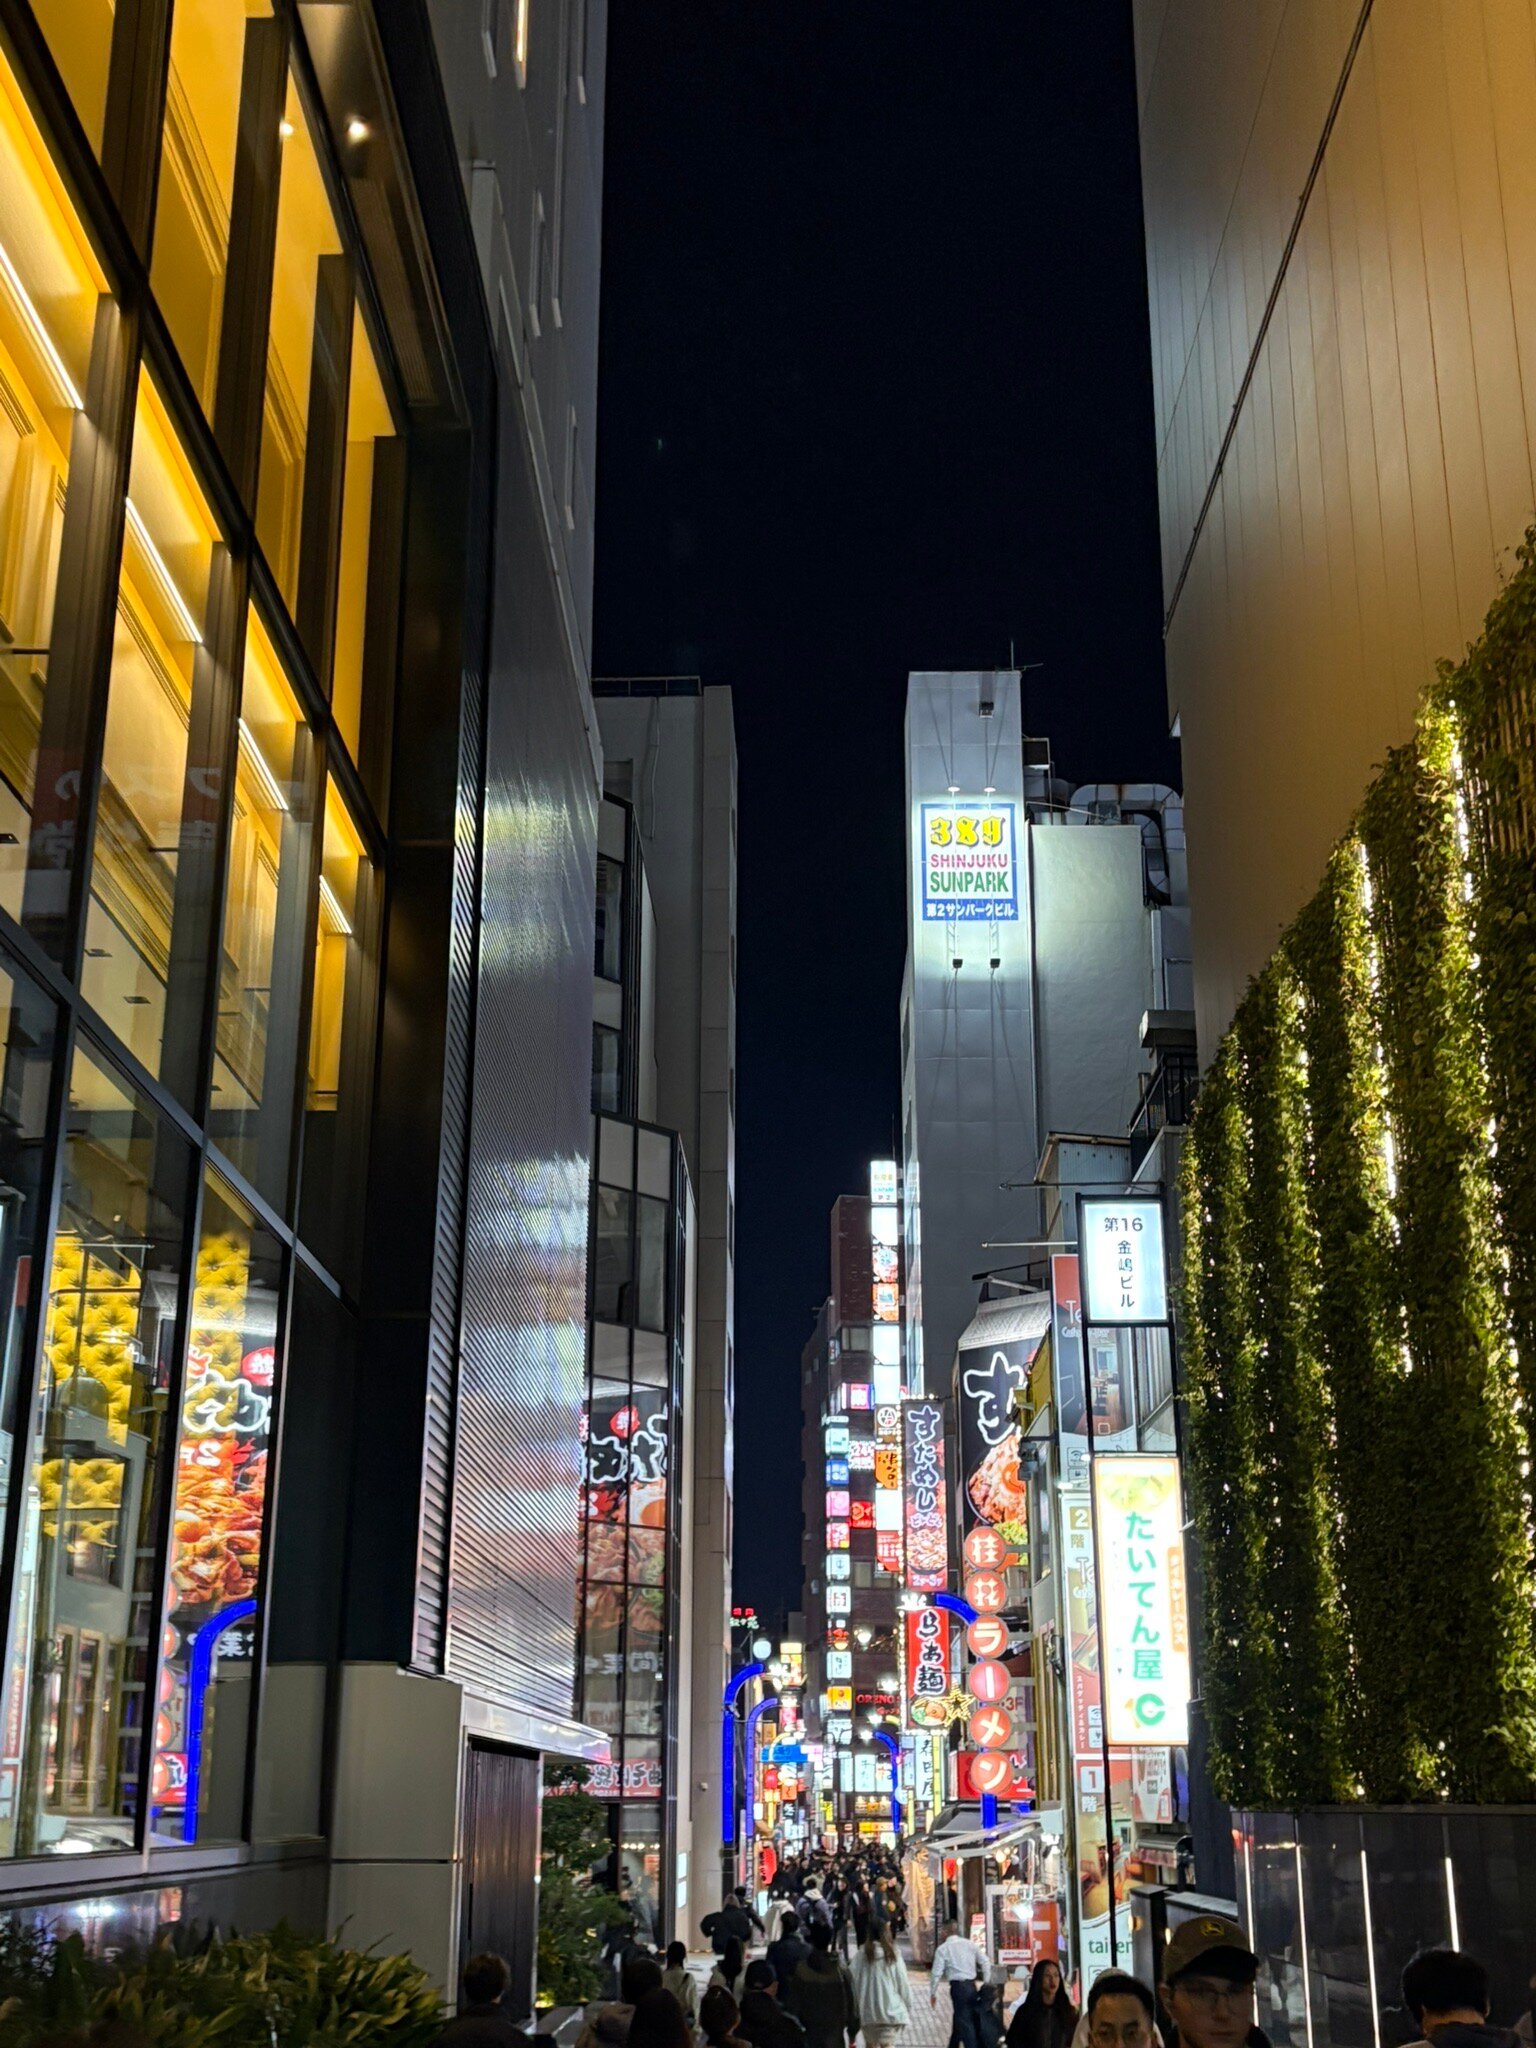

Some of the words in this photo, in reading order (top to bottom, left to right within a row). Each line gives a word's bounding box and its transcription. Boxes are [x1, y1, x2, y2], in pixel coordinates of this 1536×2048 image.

[929, 816, 1006, 847] 389
[930, 853, 1008, 868] SHINJUKU
[930, 871, 1009, 893] SUNPARK
[926, 903, 1015, 917] 第2サンパークビル
[1103, 1215, 1144, 1233] 第16
[1117, 1240, 1136, 1308] 金嶋ビル
[907, 1405, 941, 1513] すためし
[1125, 1511, 1164, 1680] たいてん屋
[971, 1536, 1008, 1789] 桂花ラーメン
